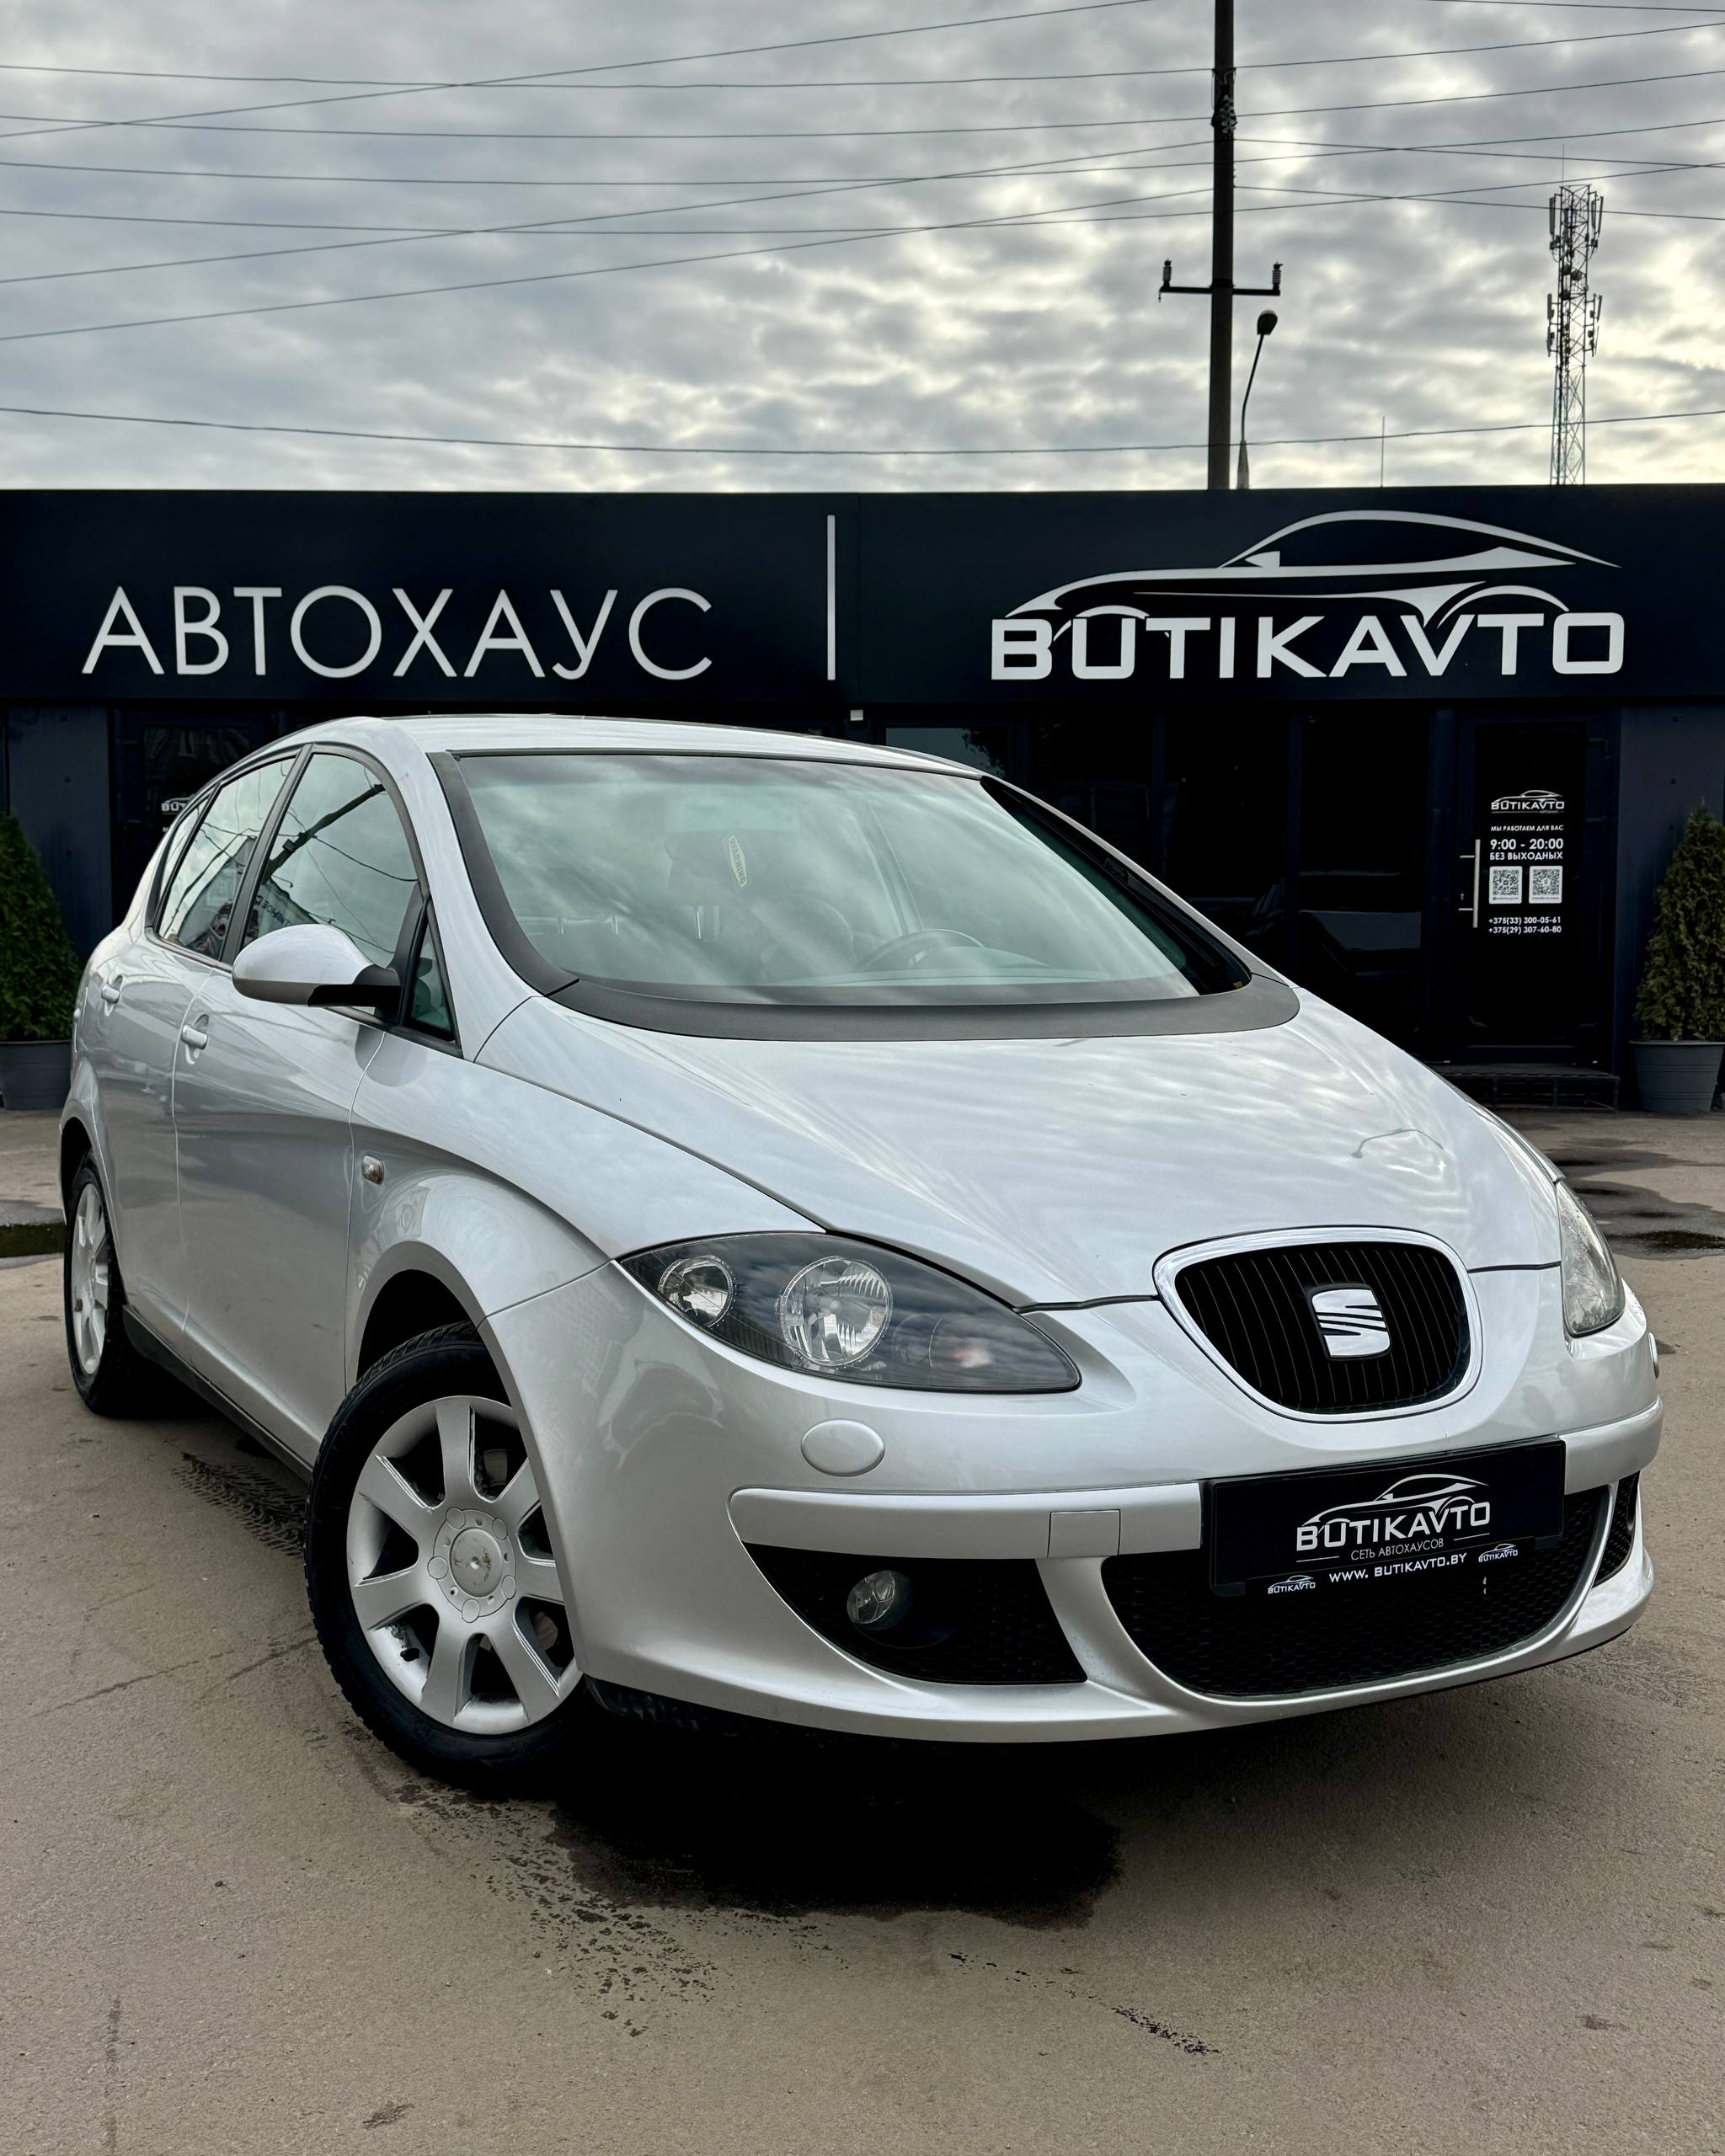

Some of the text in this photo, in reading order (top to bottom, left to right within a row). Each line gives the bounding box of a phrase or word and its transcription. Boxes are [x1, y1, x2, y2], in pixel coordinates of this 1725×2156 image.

[82, 585, 713, 680] АВТОХАУС
[991, 612, 1626, 680] BUTIKAVTO
[1491, 801, 1565, 810] BUTIKAVTO
[1490, 839, 1516, 850] 9:00
[1529, 838, 1564, 850] 20:00
[1489, 851, 1563, 861] БЕЗ ВЫХОДНЫХ
[1524, 916, 1561, 925] 300-05-61
[1296, 1502, 1490, 1550] BUTIKAVTO
[1350, 1537, 1445, 1561] СЕТЬ АВТОХАУСОВ
[1478, 1549, 1518, 1562] BUTIKAVTO
[1329, 1551, 1468, 1583] WWW. BUTIKAVTO.BY
[1268, 1582, 1316, 1594] BUTIKAVTO
